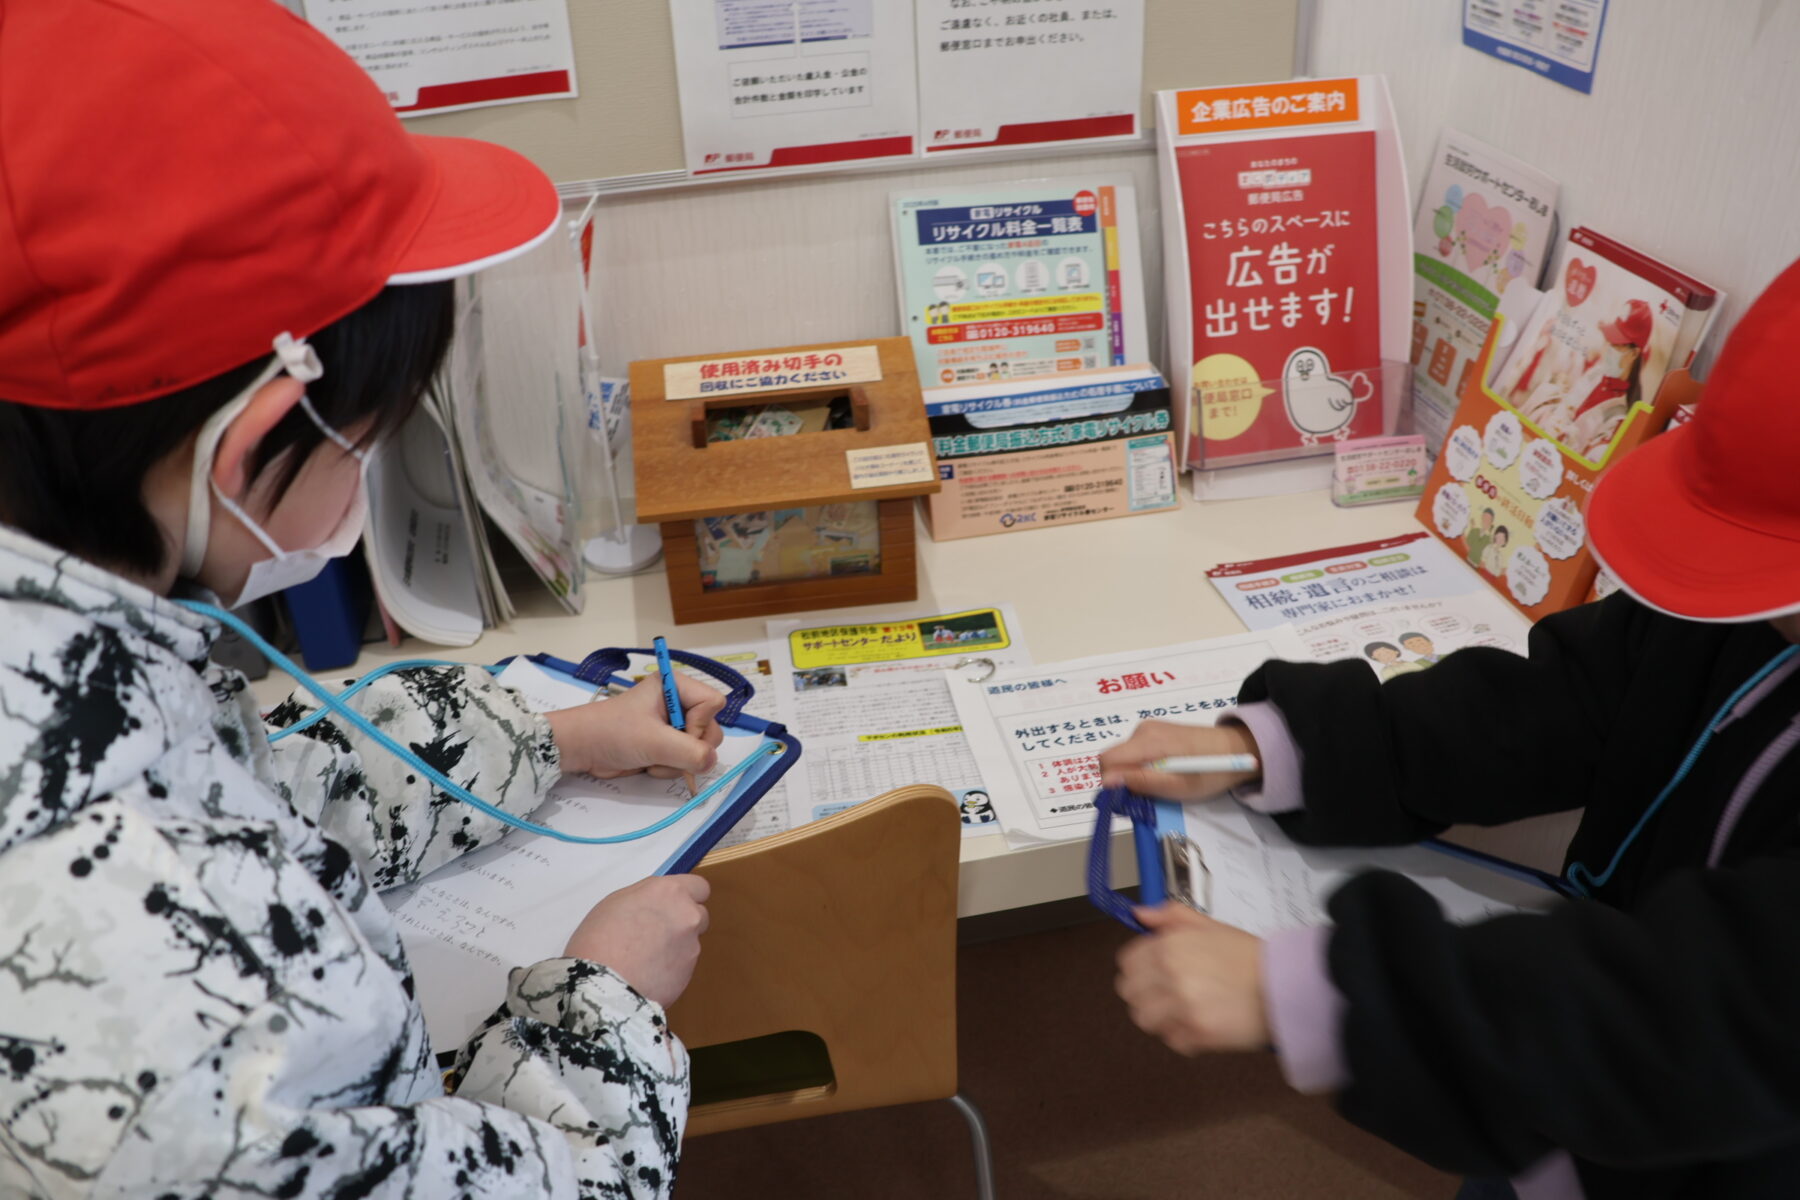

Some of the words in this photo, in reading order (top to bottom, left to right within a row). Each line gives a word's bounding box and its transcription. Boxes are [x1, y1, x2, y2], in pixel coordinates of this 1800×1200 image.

[1191, 91, 1346, 123] 企業広告のご案内
[932, 216, 1083, 242] リサイクル料金一覧表
[1203, 210, 1351, 239] こちらのスペースに
[1226, 241, 1336, 288] 広告が
[700, 353, 843, 379] 使用済み切手の
[700, 371, 848, 393] 回収にご協力ください
[1245, 566, 1428, 611] 相続・遺言のご相談は
[987, 678, 1067, 695] 道民の皆様へ
[1096, 671, 1177, 694] お願い
[1021, 730, 1122, 752] してください。
